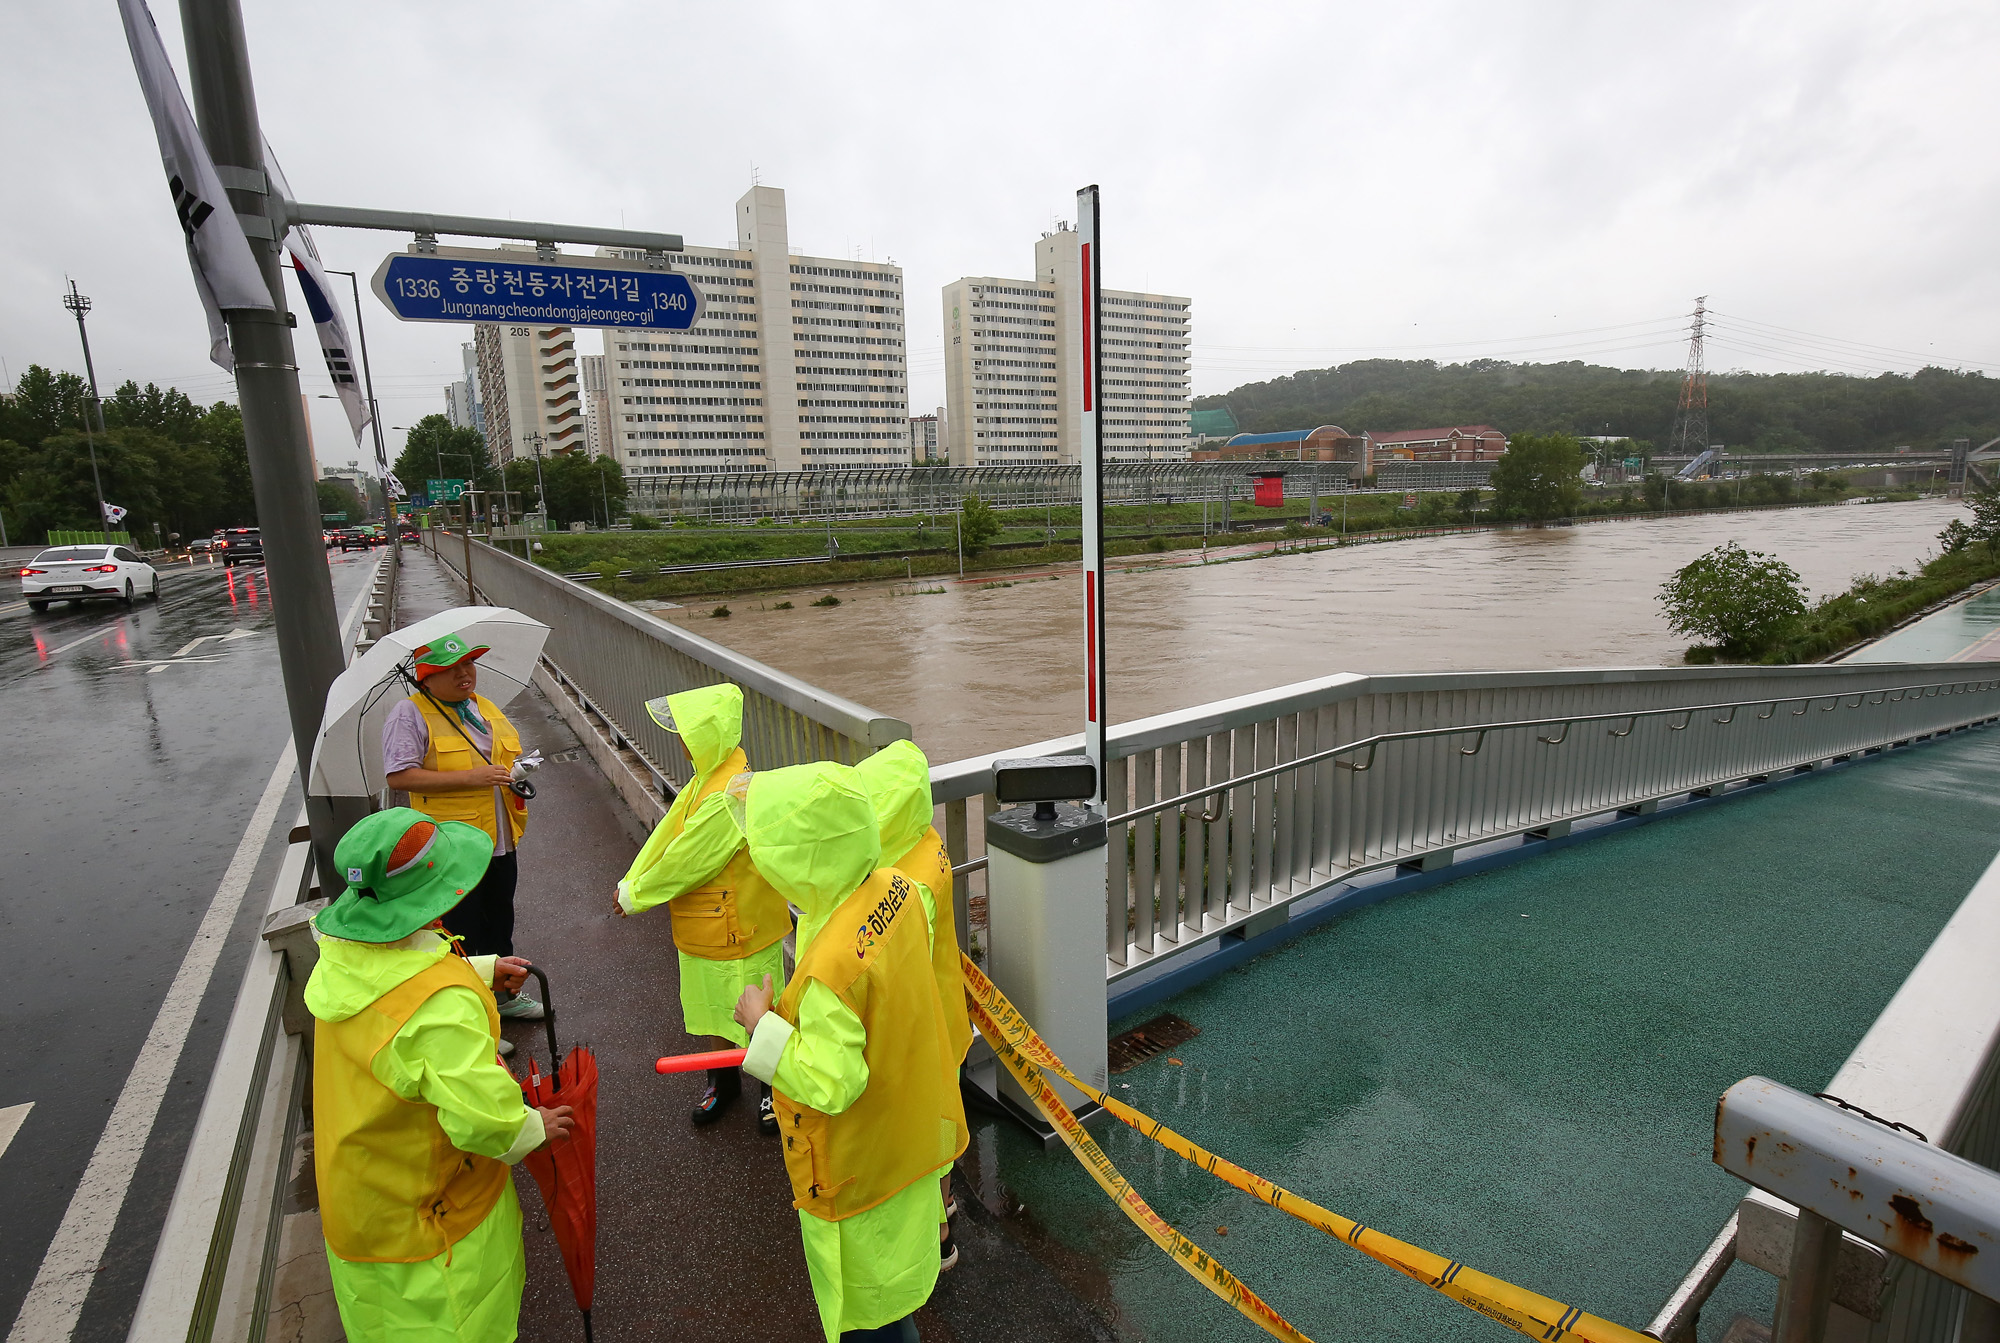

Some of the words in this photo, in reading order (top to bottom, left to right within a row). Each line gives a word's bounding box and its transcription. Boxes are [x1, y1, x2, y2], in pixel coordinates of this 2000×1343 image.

[396, 278, 440, 299] 1336
[449, 267, 640, 302] 중랑천동자전거길
[441, 298, 654, 325] Jungnangcheondongjajeongeo-gil
[652, 292, 687, 311] 1340
[510, 327, 530, 338] 205
